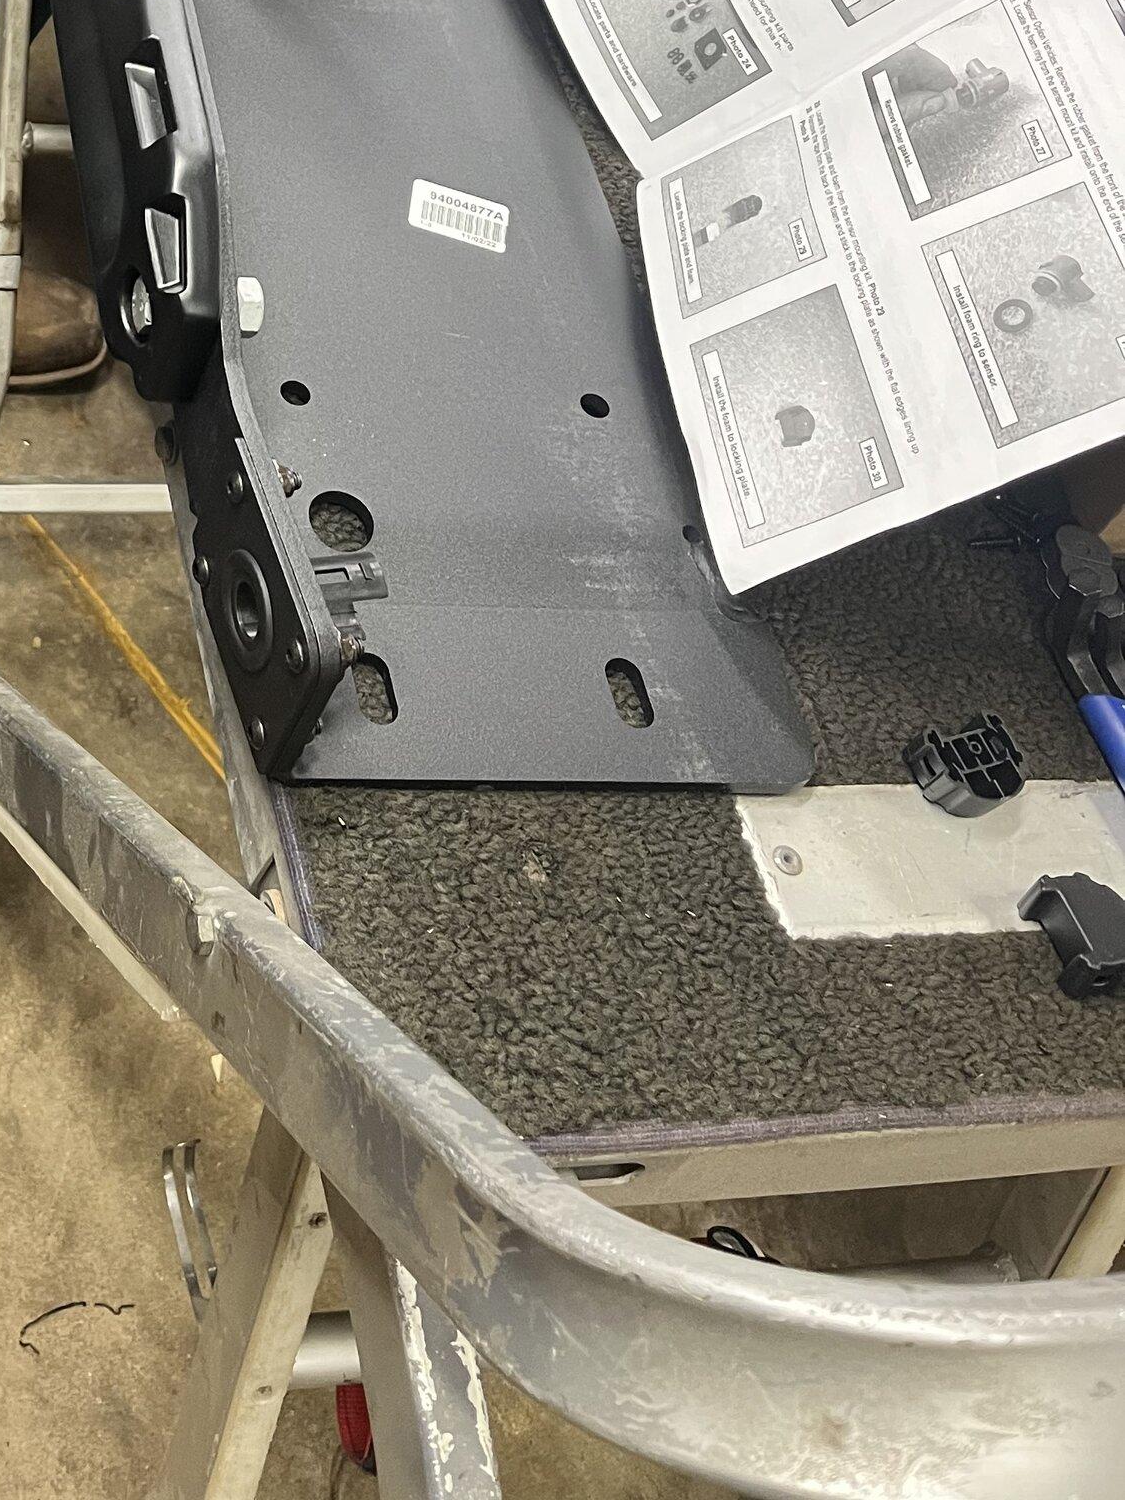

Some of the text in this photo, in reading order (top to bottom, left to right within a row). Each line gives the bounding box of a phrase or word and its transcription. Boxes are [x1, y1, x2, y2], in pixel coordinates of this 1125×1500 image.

[597, 19, 612, 39] parts
[608, 38, 620, 53] and
[757, 15, 769, 26] for
[764, 25, 778, 41] this
[773, 21, 785, 32] kit
[1021, 24, 1032, 35] the
[726, 34, 752, 69] Photo 24
[778, 31, 795, 52] parts
[1038, 60, 1051, 76] from
[1045, 75, 1056, 86] the
[1054, 66, 1072, 92] Remove
[1050, 86, 1065, 107] sensor
[1066, 92, 1077, 103] the
[1060, 107, 1075, 127] mount
[1071, 103, 1087, 124] rubber
[892, 122, 904, 143] rubber
[1027, 126, 1045, 156] Photo 27
[1073, 135, 1085, 149] and
[1079, 124, 1097, 146] gasket
[1079, 148, 1094, 169] install
[1091, 145, 1104, 161] from
[1088, 168, 1102, 185] onto
[1099, 162, 1110, 174] the
[1096, 185, 1108, 197] the
[1104, 173, 1119, 191] front
[1102, 197, 1115, 212] end
[1112, 190, 1123, 199] of
[430, 190, 504, 222] 94004877A
[1109, 212, 1119, 220] of
[791, 224, 804, 245] Photo
[1112, 220, 1124, 232] the
[844, 217, 856, 239] sensor
[850, 238, 869, 271] mounting
[867, 282, 881, 305] Photo
[847, 260, 858, 273] the
[851, 272, 867, 299] locking
[860, 298, 874, 318] plate
[867, 317, 876, 327] as
[871, 327, 885, 351] shown
[953, 284, 998, 390] Install foam ring to sensor.
[879, 351, 891, 367] with
[885, 367, 896, 381] the
[889, 381, 900, 394] flat
[893, 395, 908, 420] edges
[712, 375, 752, 499] Install the foam to locking plate.
[901, 420, 915, 443] lining
[908, 443, 918, 455] up
[864, 445, 881, 481] Photo 30
